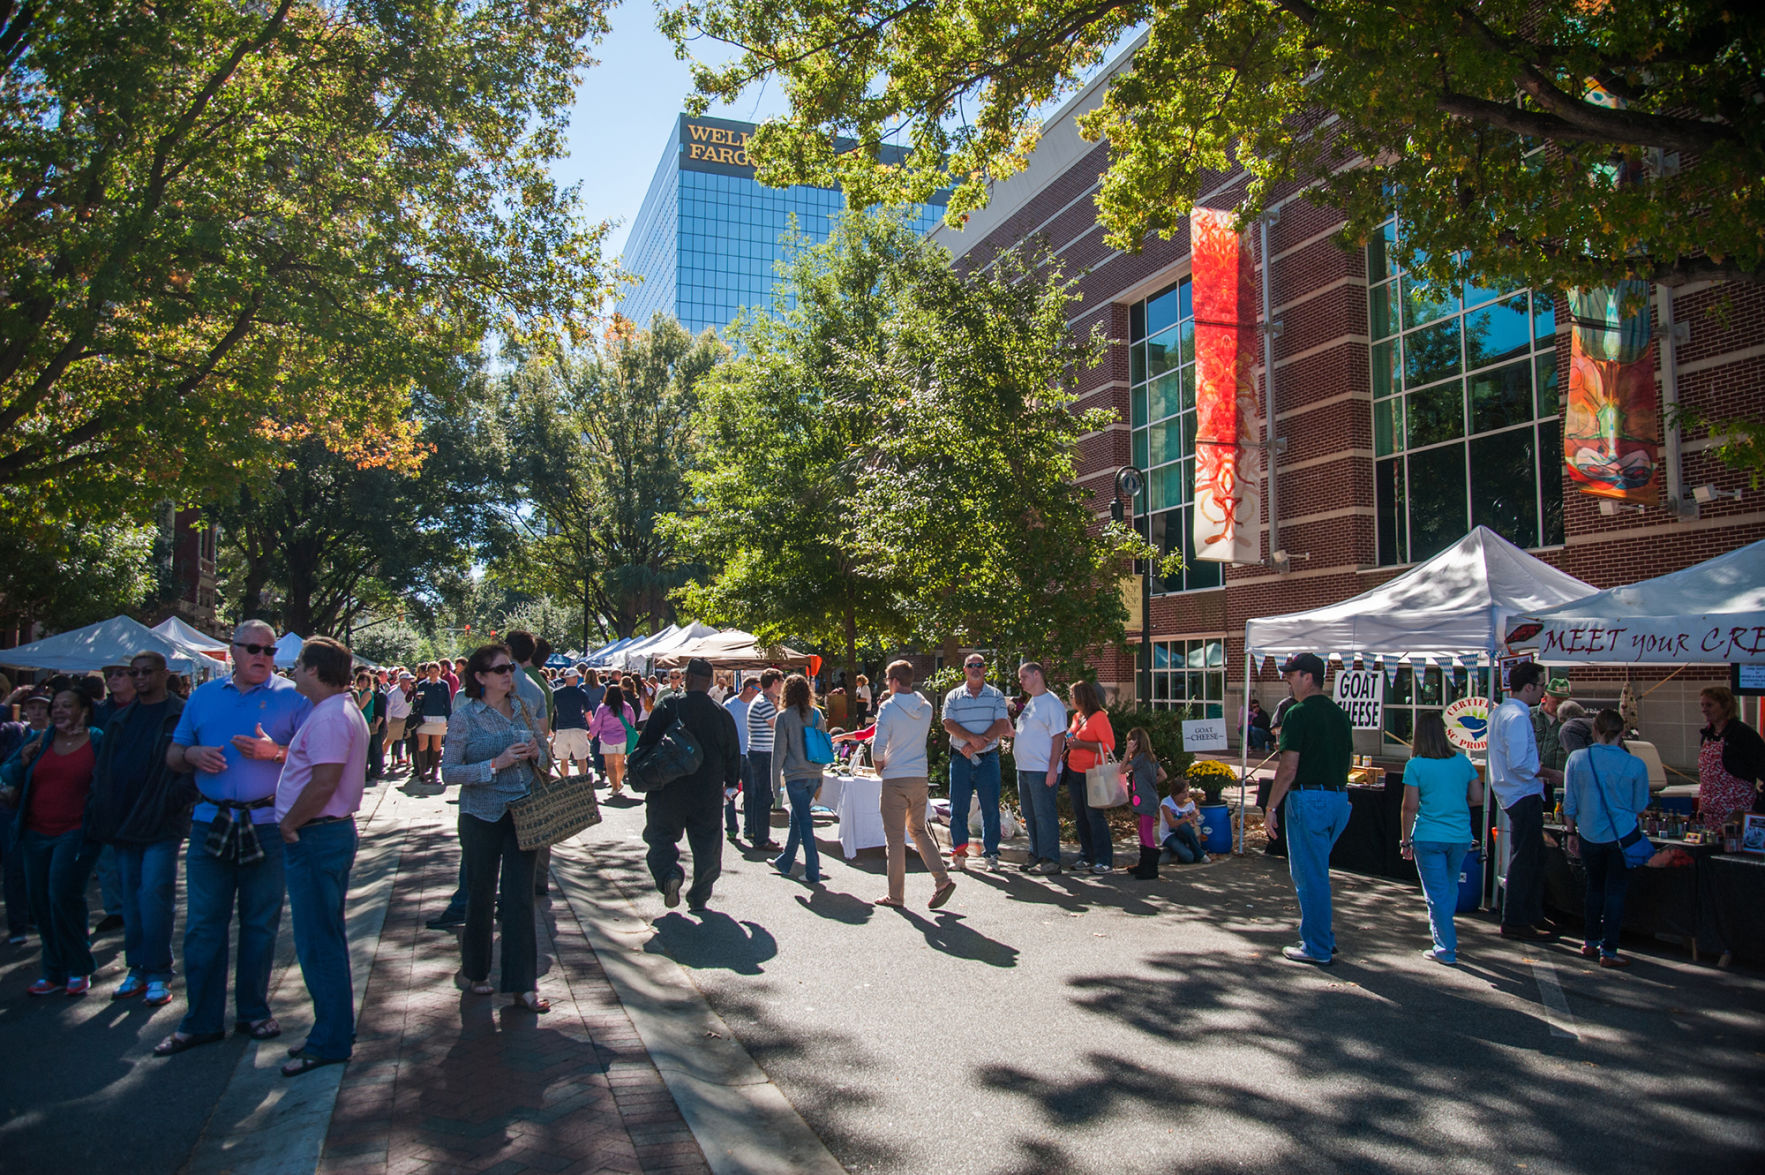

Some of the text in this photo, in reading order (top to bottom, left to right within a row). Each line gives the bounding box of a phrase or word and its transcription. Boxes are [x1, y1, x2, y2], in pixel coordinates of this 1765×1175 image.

[687, 124, 749, 147] WELL
[1543, 628, 1628, 655] MEET
[1701, 626, 1765, 659] CRE
[1340, 673, 1379, 699] GOAT
[1337, 701, 1379, 727] HEESE
[1446, 728, 1459, 742] SC
